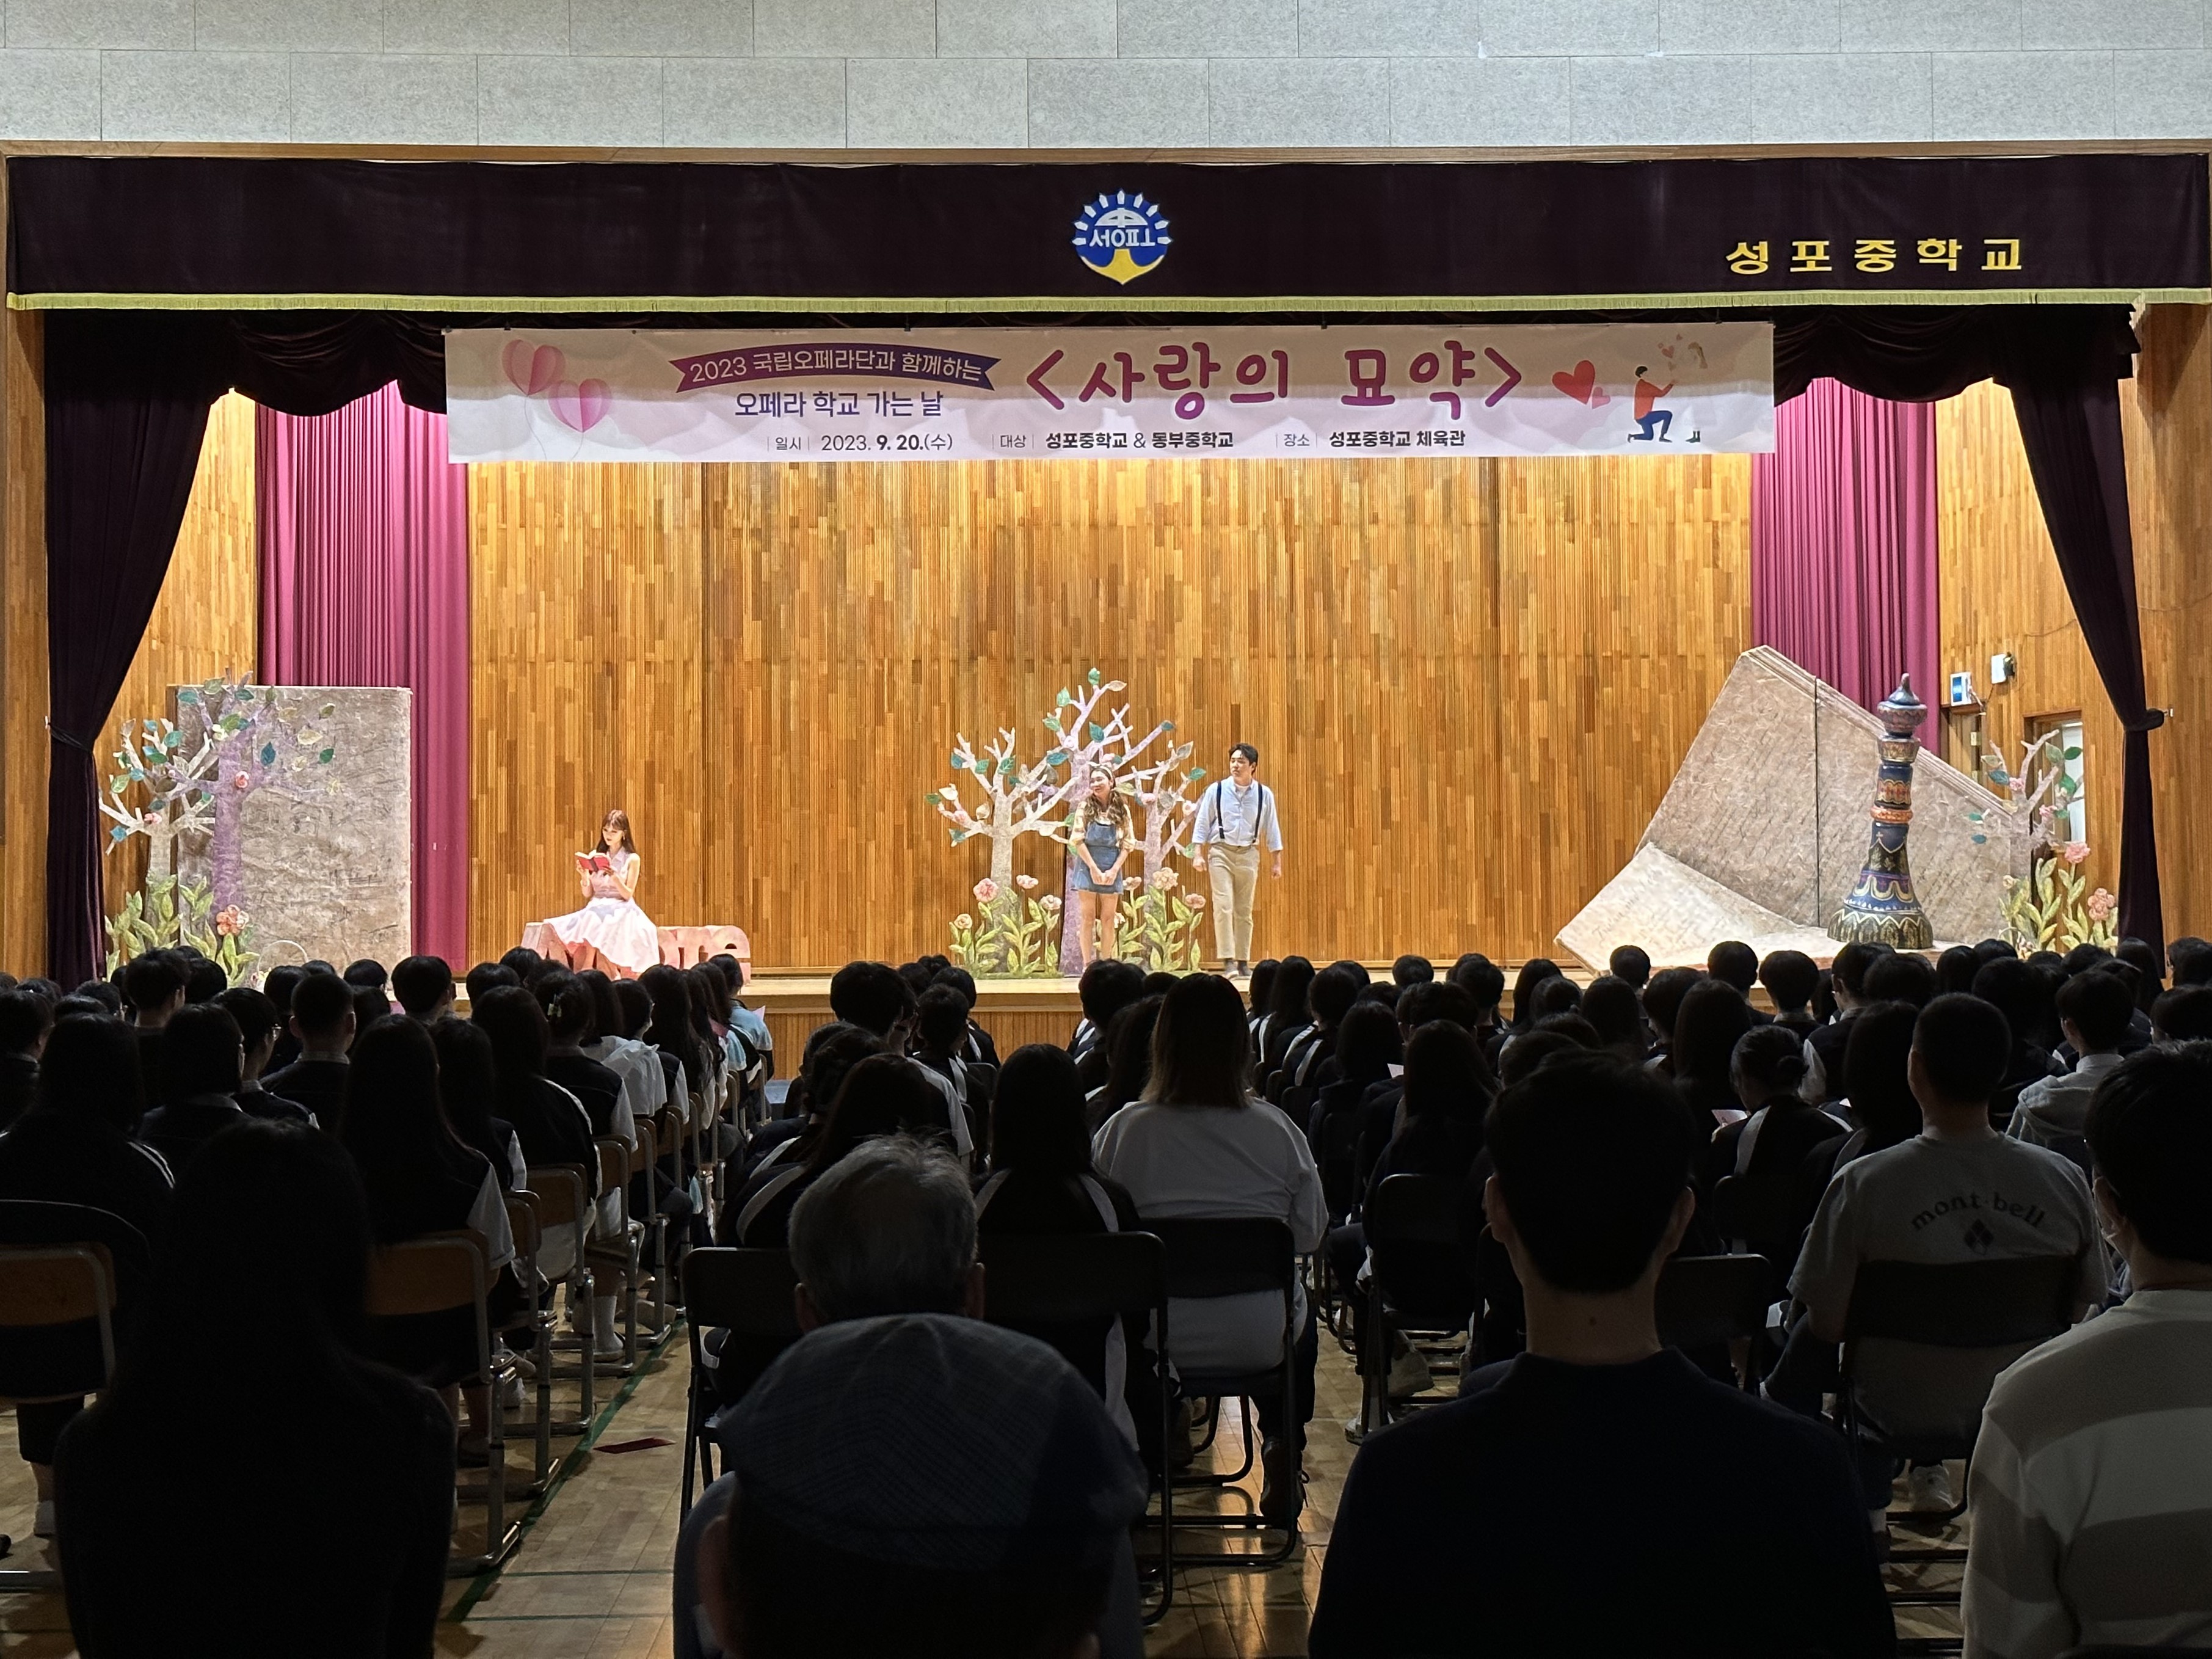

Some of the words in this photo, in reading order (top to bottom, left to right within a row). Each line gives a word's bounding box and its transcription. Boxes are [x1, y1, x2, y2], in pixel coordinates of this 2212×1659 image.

[1726, 238, 2022, 275] 성포중학교
[689, 357, 748, 383] 2023
[752, 350, 896, 373] 국립오페라단과
[901, 352, 982, 382] 함께하는
[735, 392, 807, 418] 오페라
[812, 390, 860, 418] 학교
[867, 390, 914, 417] 가는
[920, 390, 944, 418] 날
[775, 436, 802, 451] 일시
[821, 434, 871, 451] 2023.
[1000, 434, 1027, 448] 대상
[1045, 432, 1128, 450] 성포중학교
[1133, 432, 1147, 449] &
[1151, 431, 1234, 449] 동부중학교
[1283, 433, 1310, 447] 장소
[1329, 431, 1411, 448] 성포중학교
[1416, 430, 1466, 447] 체육관
